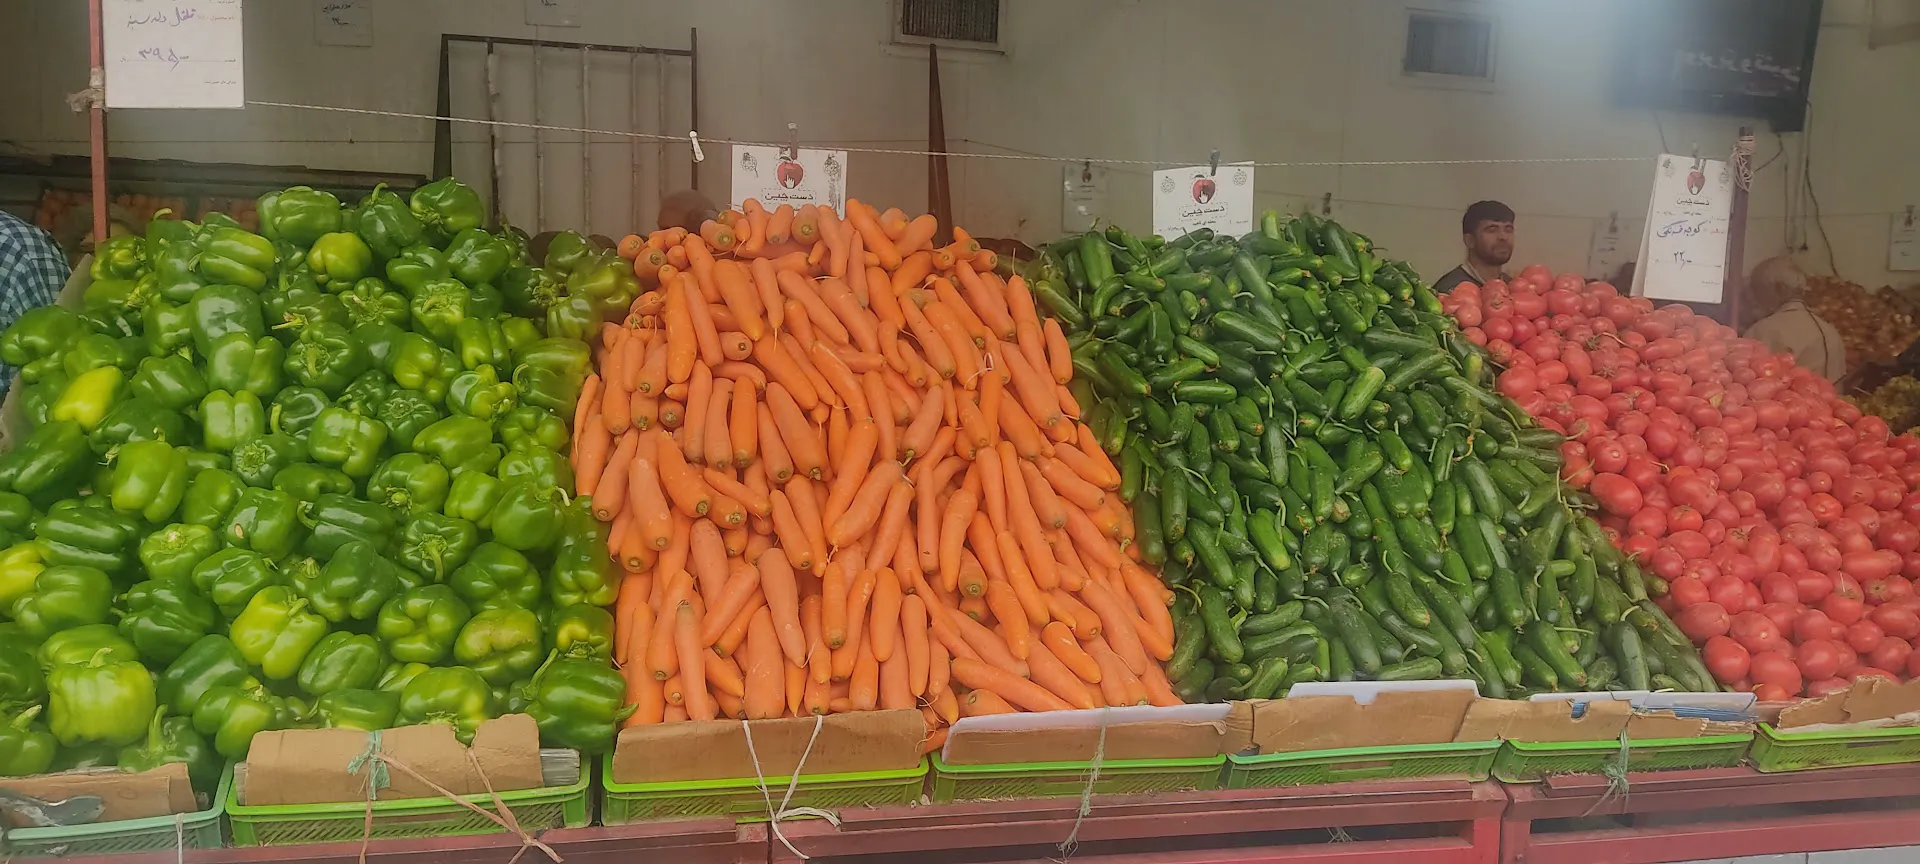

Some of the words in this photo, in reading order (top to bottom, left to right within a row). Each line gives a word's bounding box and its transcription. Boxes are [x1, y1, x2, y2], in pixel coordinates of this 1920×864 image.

[764, 192, 789, 202] چین
[789, 192, 814, 201] دست
[1676, 197, 1693, 207] چین
[1181, 207, 1204, 218] چین
[1203, 205, 1225, 213] دست
